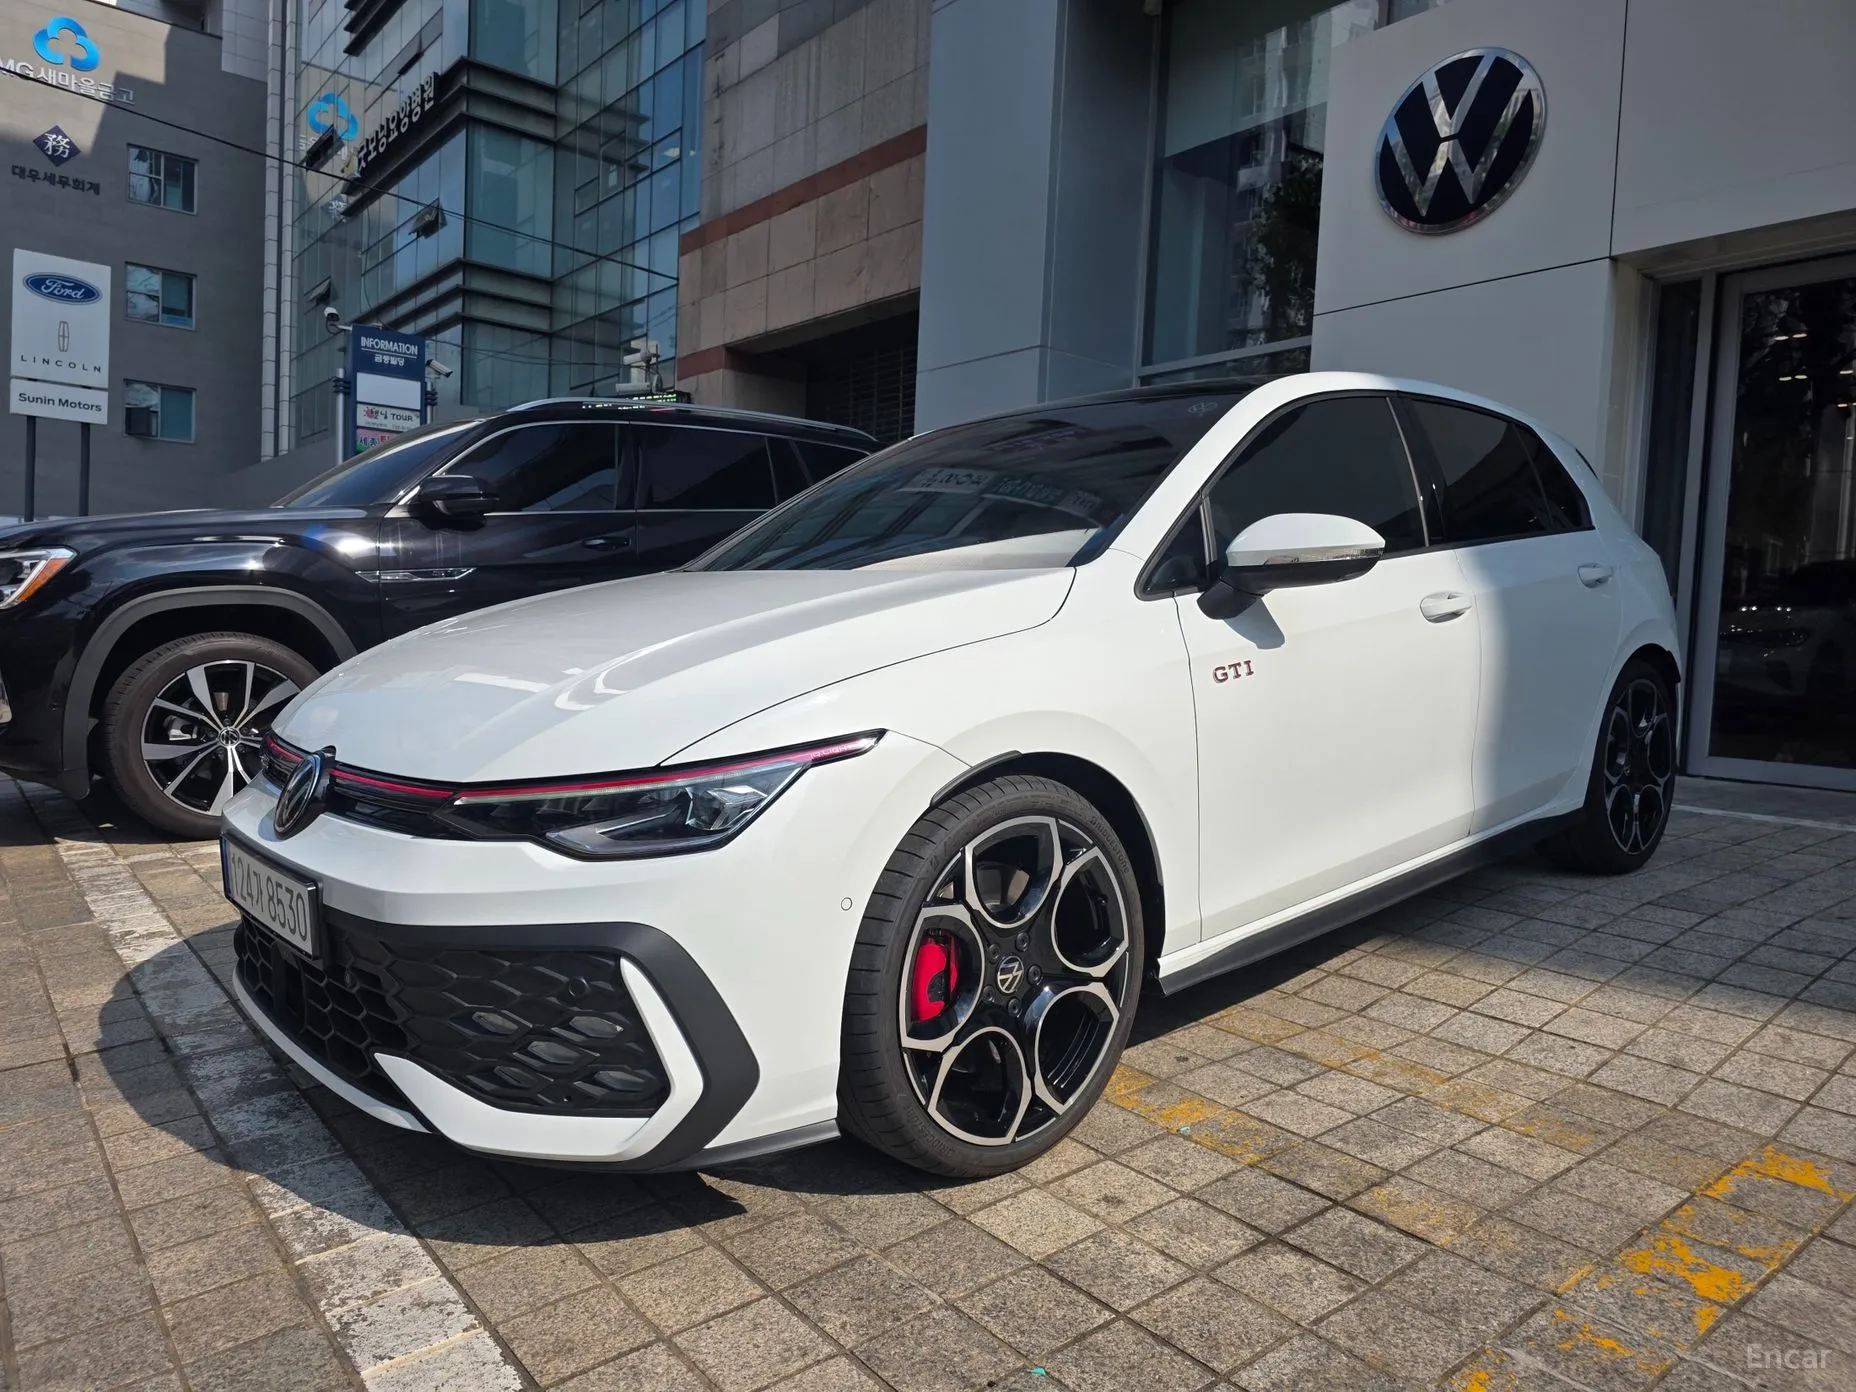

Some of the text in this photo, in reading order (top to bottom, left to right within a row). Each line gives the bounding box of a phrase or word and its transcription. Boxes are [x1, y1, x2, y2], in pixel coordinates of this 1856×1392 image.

[11, 164, 100, 196] 대우세무회계
[41, 278, 86, 300] Ford
[361, 336, 418, 356] INFORMATION
[20, 354, 102, 373] LINCOLN
[18, 392, 102, 412] Sunin Motors
[390, 412, 414, 422] TOUR
[1213, 659, 1254, 684] GTI
[231, 855, 308, 942] 124가 8530
